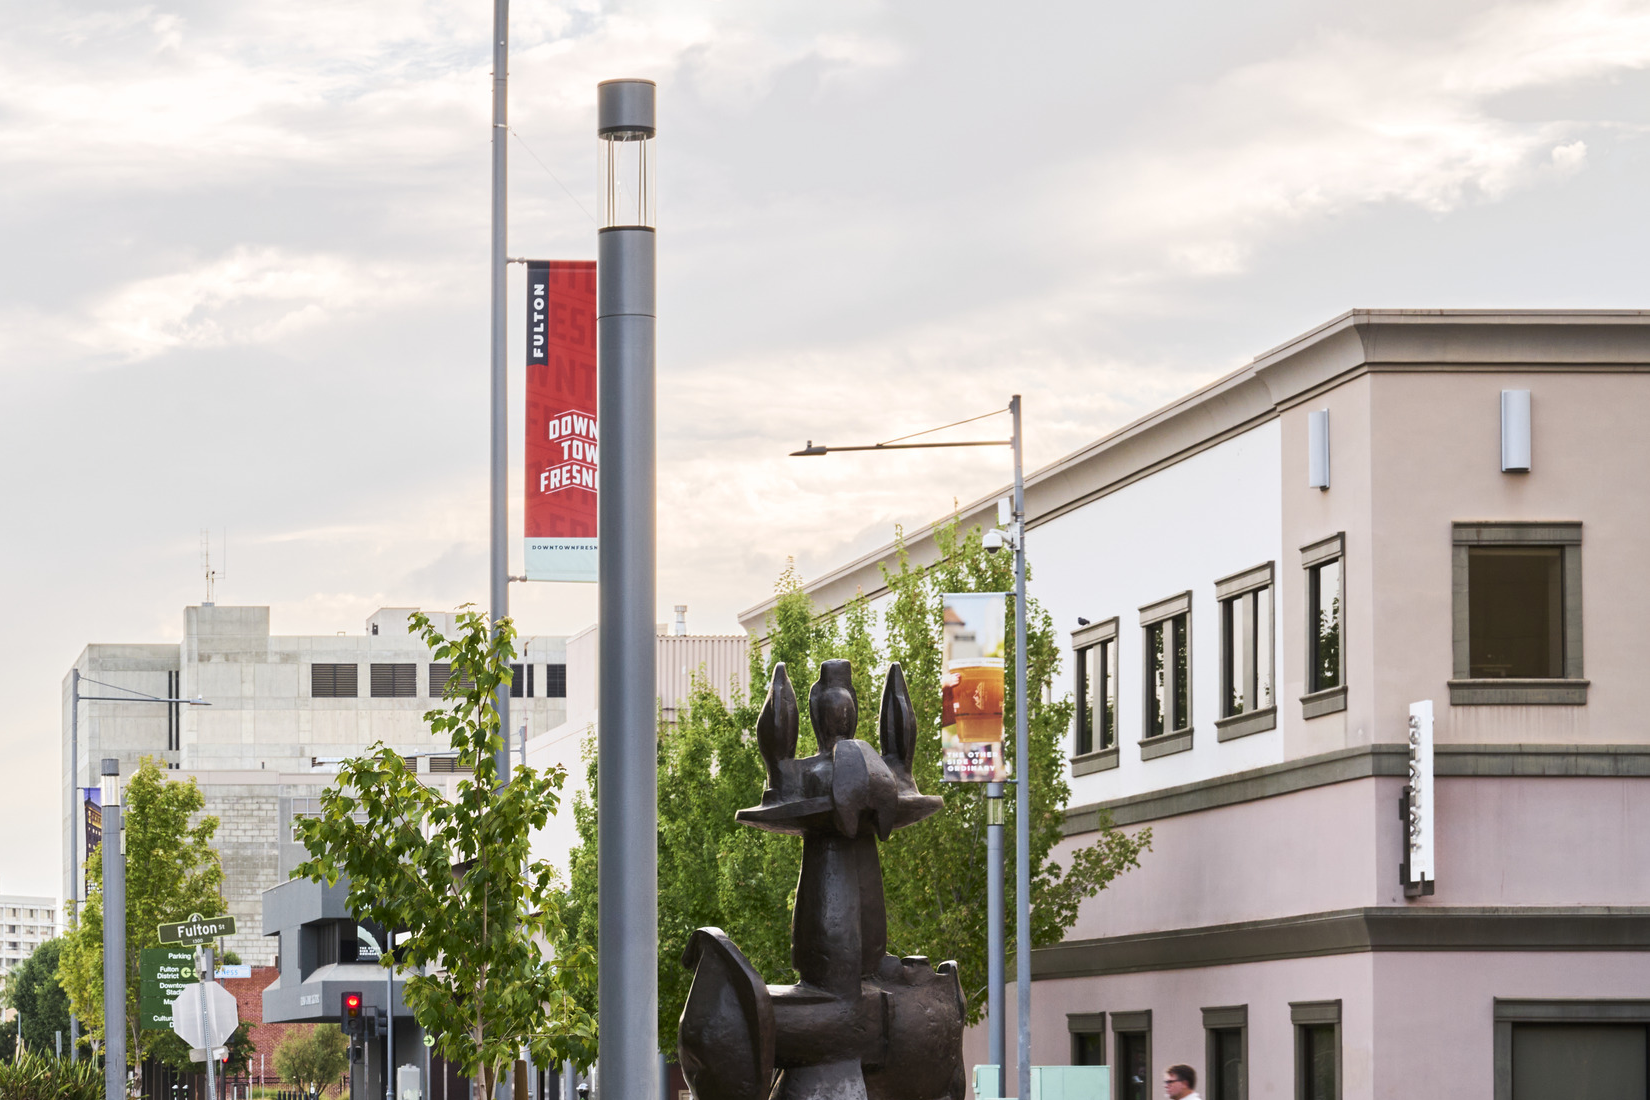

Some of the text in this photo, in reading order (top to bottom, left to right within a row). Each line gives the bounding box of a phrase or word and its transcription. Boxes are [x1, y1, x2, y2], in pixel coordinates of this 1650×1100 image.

[533, 284, 544, 357] FULTON
[549, 414, 598, 440] DOWN
[177, 924, 217, 938] Fulton
